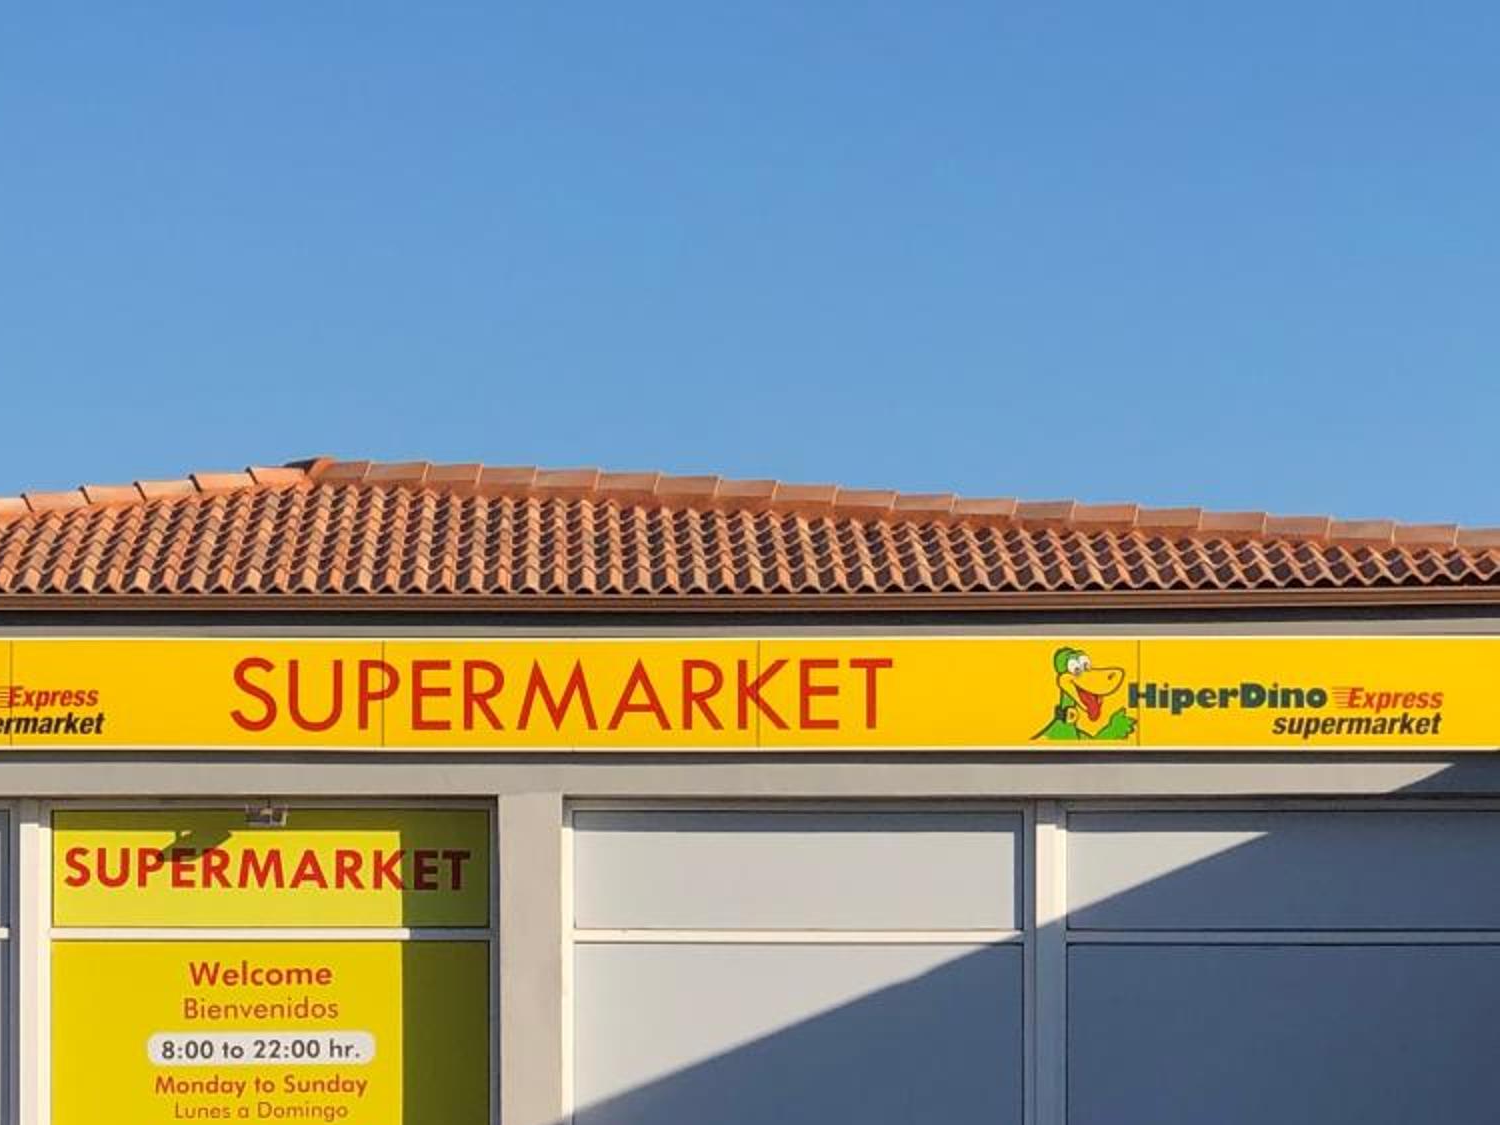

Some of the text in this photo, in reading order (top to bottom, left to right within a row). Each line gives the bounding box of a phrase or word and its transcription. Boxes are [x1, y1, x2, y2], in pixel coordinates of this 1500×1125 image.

[8, 686, 99, 711] Express
[230, 657, 892, 732] SUPERMARKET
[1128, 682, 1444, 715] HiperDino Express
[1272, 713, 1443, 739] supermarket
[64, 847, 471, 891] SUPERMARKET
[188, 960, 333, 987] Welcome
[183, 996, 339, 1020] Bienvenidos
[161, 1037, 360, 1060] 8:00 to 22:00 hr.
[155, 1073, 368, 1098] Monday to Sunday
[174, 1101, 349, 1122] Lunes a Domingo
